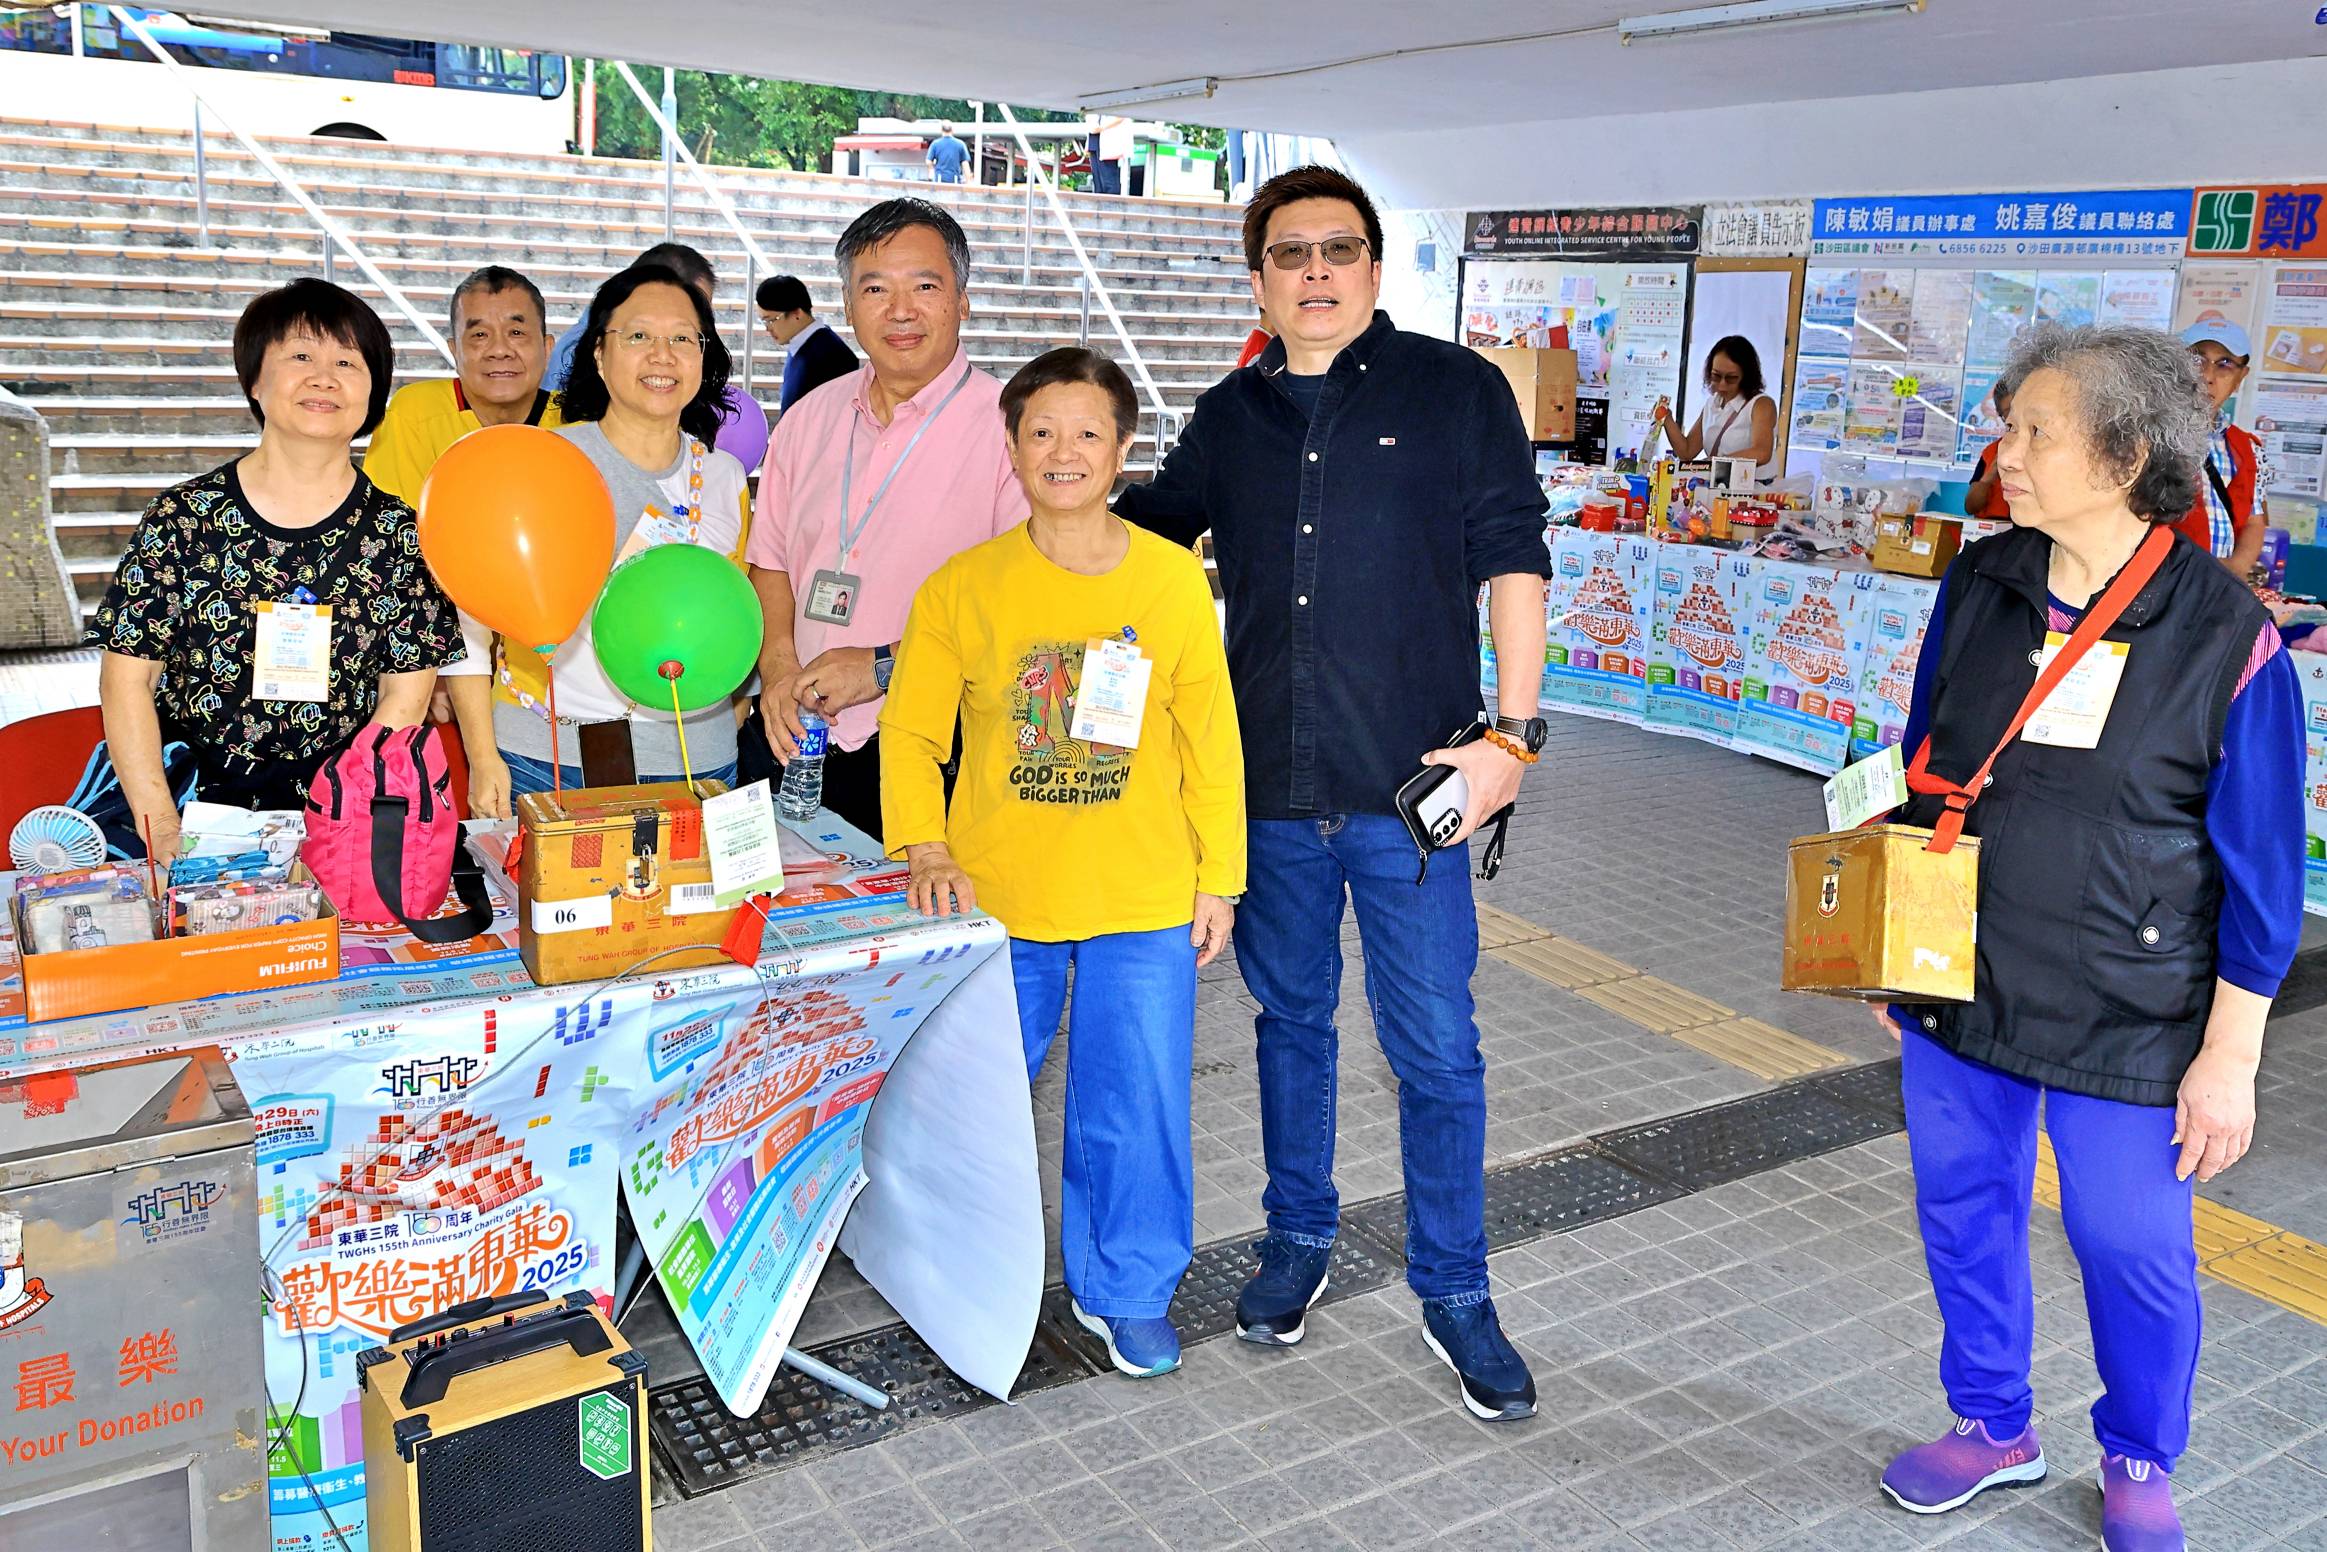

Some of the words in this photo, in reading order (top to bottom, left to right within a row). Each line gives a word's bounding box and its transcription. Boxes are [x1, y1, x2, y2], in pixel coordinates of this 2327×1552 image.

[1825, 206, 1976, 233] 陳敏娟議員辦事處
[1995, 202, 2175, 232] 姚嘉俊議員聯絡處
[2258, 193, 2323, 250] 鄭
[1581, 236, 1604, 244] SERVICE
[1644, 235, 1665, 243] YOUNG
[1666, 234, 1691, 242] PEOPLE
[1825, 243, 1869, 254] 沙田區議會
[1949, 243, 1975, 254] 6856
[1979, 243, 2007, 254] 6225
[1829, 676, 1850, 688] 2025
[1010, 765, 1053, 785] GOD
[1074, 770, 1088, 783] SO
[1090, 766, 1130, 787] MUCH
[1082, 787, 1121, 804] THAN
[555, 907, 577, 925] 06
[968, 920, 991, 928] HKT
[288, 940, 328, 953] Choice
[578, 954, 599, 962] TUNG
[602, 951, 620, 959] WAH
[621, 947, 648, 957] GROUP
[259, 957, 328, 977] FUJIFILM
[681, 1036, 698, 1048] 1878
[700, 1028, 713, 1038] 333
[145, 1045, 180, 1055] HKT
[821, 1051, 878, 1084] 2025
[665, 1036, 875, 1171] 歡樂滿東華
[269, 1133, 292, 1145] 1878
[295, 1130, 315, 1139] 333
[849, 1173, 862, 1192] HKT
[338, 1223, 399, 1247] 東華三院
[445, 1210, 473, 1229] 周年
[338, 1247, 377, 1260] TWGHs
[379, 1239, 410, 1253] 155th
[411, 1227, 474, 1248] Anniversary
[474, 1214, 505, 1233] Charity
[505, 1204, 524, 1218] Gala
[274, 1204, 567, 1331] 歡樂滿東華
[522, 1243, 584, 1292] 2025
[6, 1297, 45, 1323] HOSPITALS
[1, 1430, 69, 1463] Your
[78, 1397, 204, 1448] Donation
